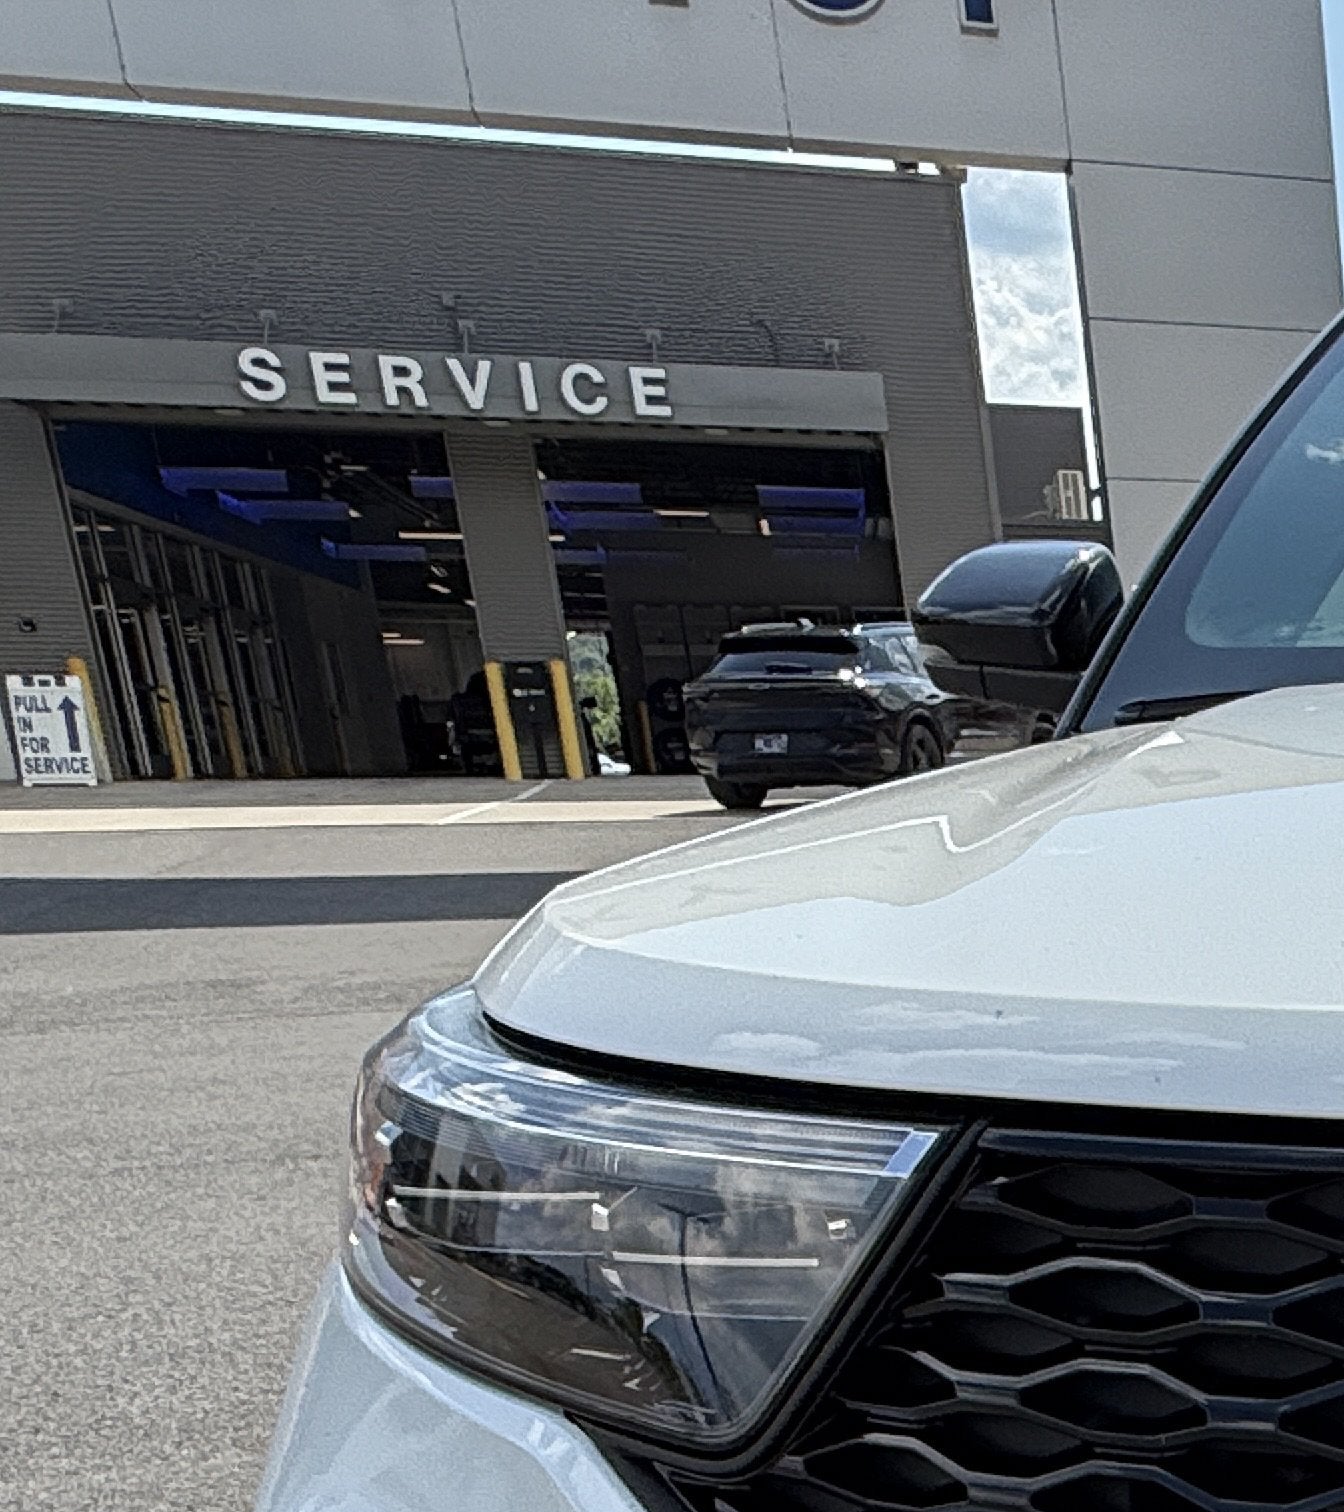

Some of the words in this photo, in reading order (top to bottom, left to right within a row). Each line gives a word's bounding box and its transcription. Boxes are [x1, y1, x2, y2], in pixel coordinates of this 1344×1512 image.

[237, 346, 674, 417] SERVICE
[13, 694, 52, 713] PULL
[17, 716, 34, 733] IN
[20, 736, 51, 753] FOR
[24, 756, 92, 774] SERVICE
